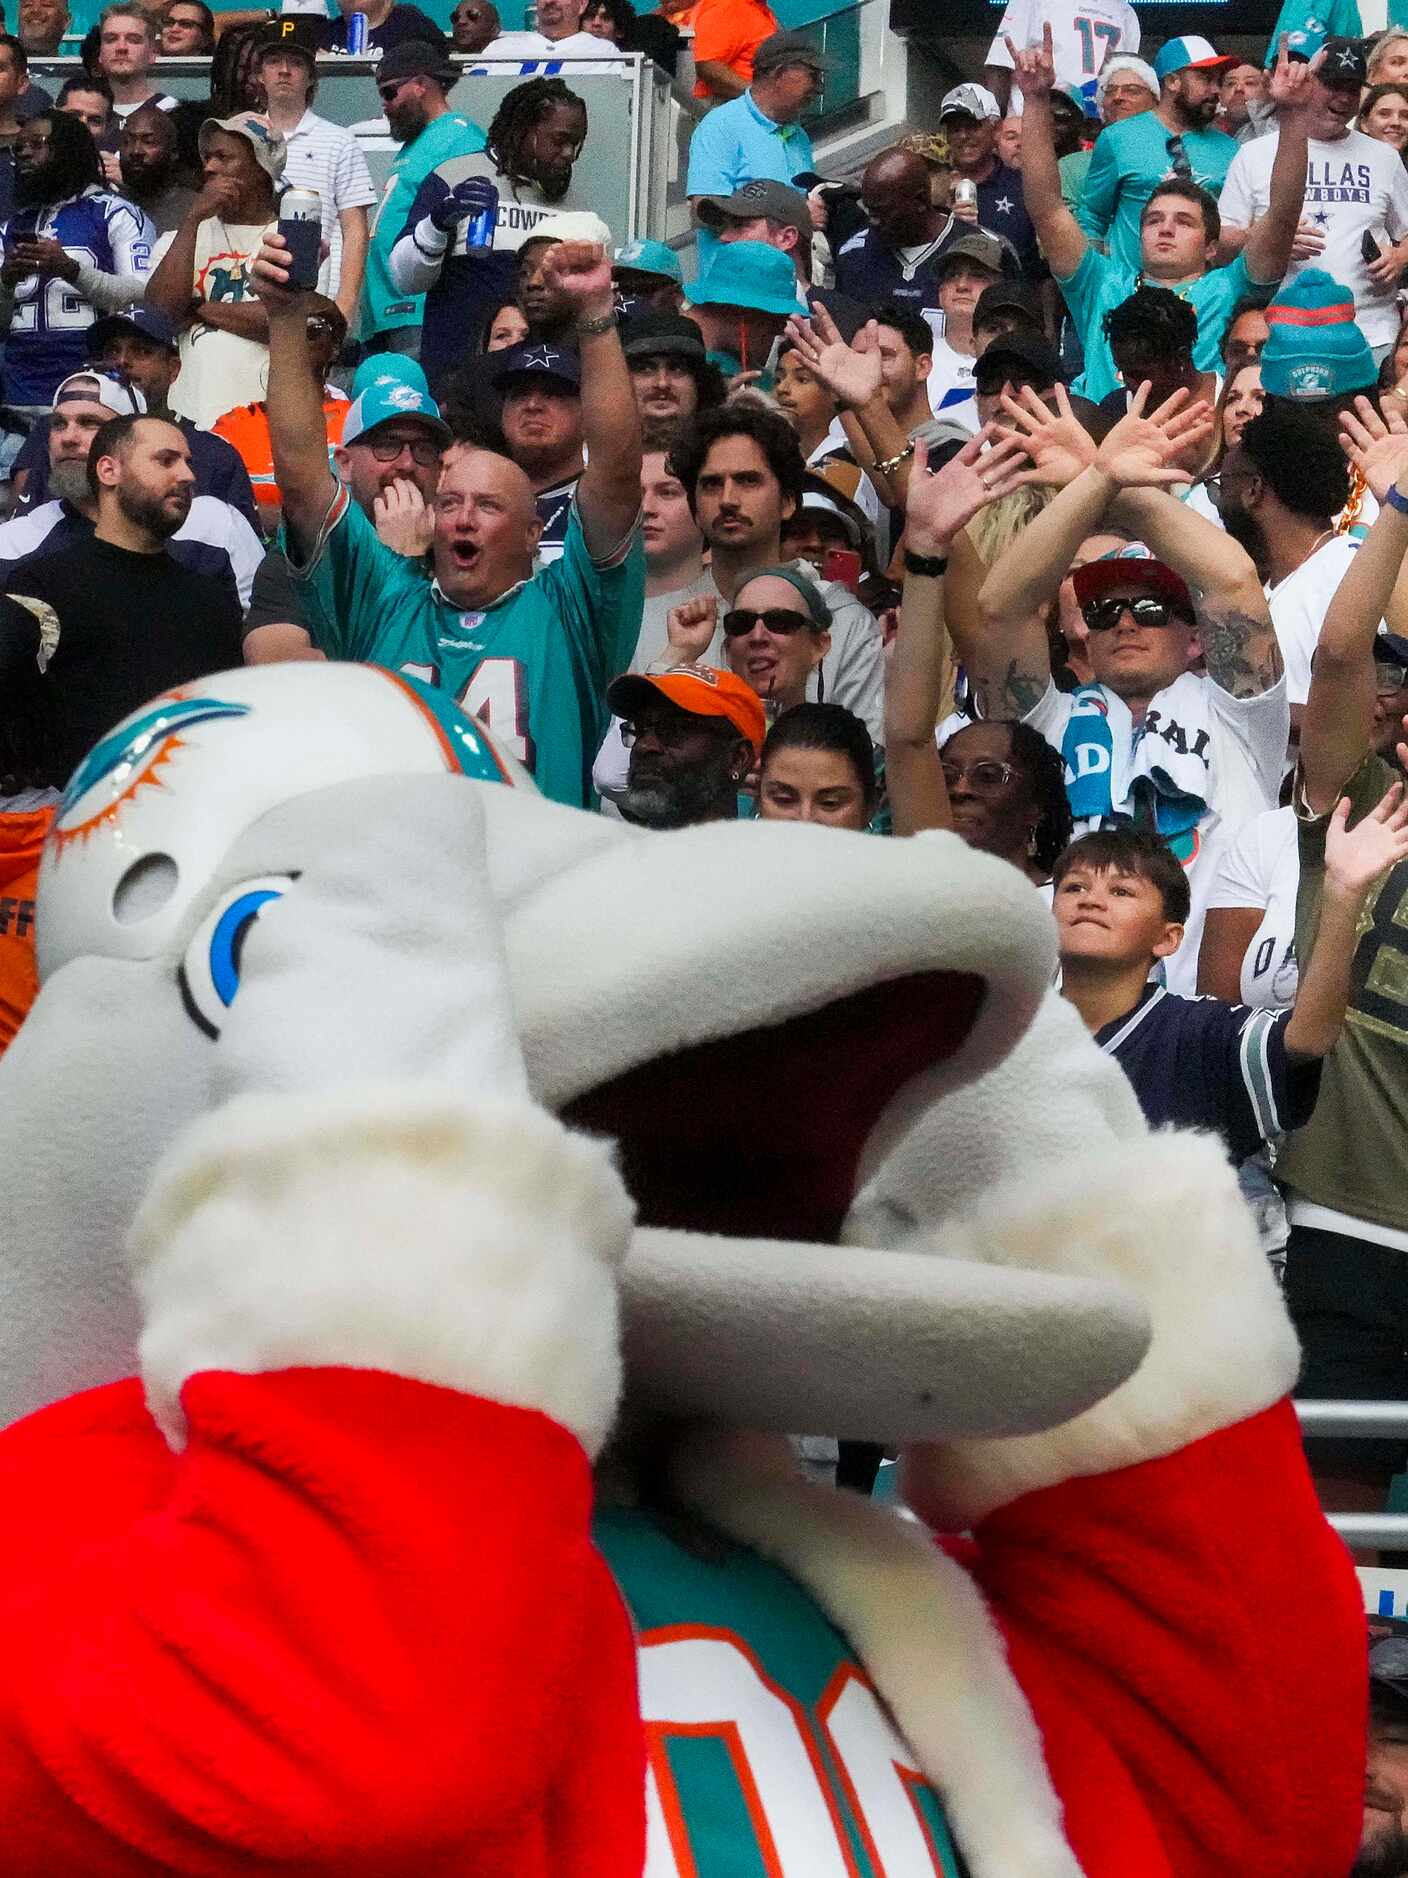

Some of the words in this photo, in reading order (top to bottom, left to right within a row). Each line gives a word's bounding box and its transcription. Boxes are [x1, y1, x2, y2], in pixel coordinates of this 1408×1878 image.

[281, 22, 295, 38] P
[1073, 16, 1122, 75] 17
[1308, 161, 1371, 188] LLAS
[1305, 187, 1369, 203] WBOYS
